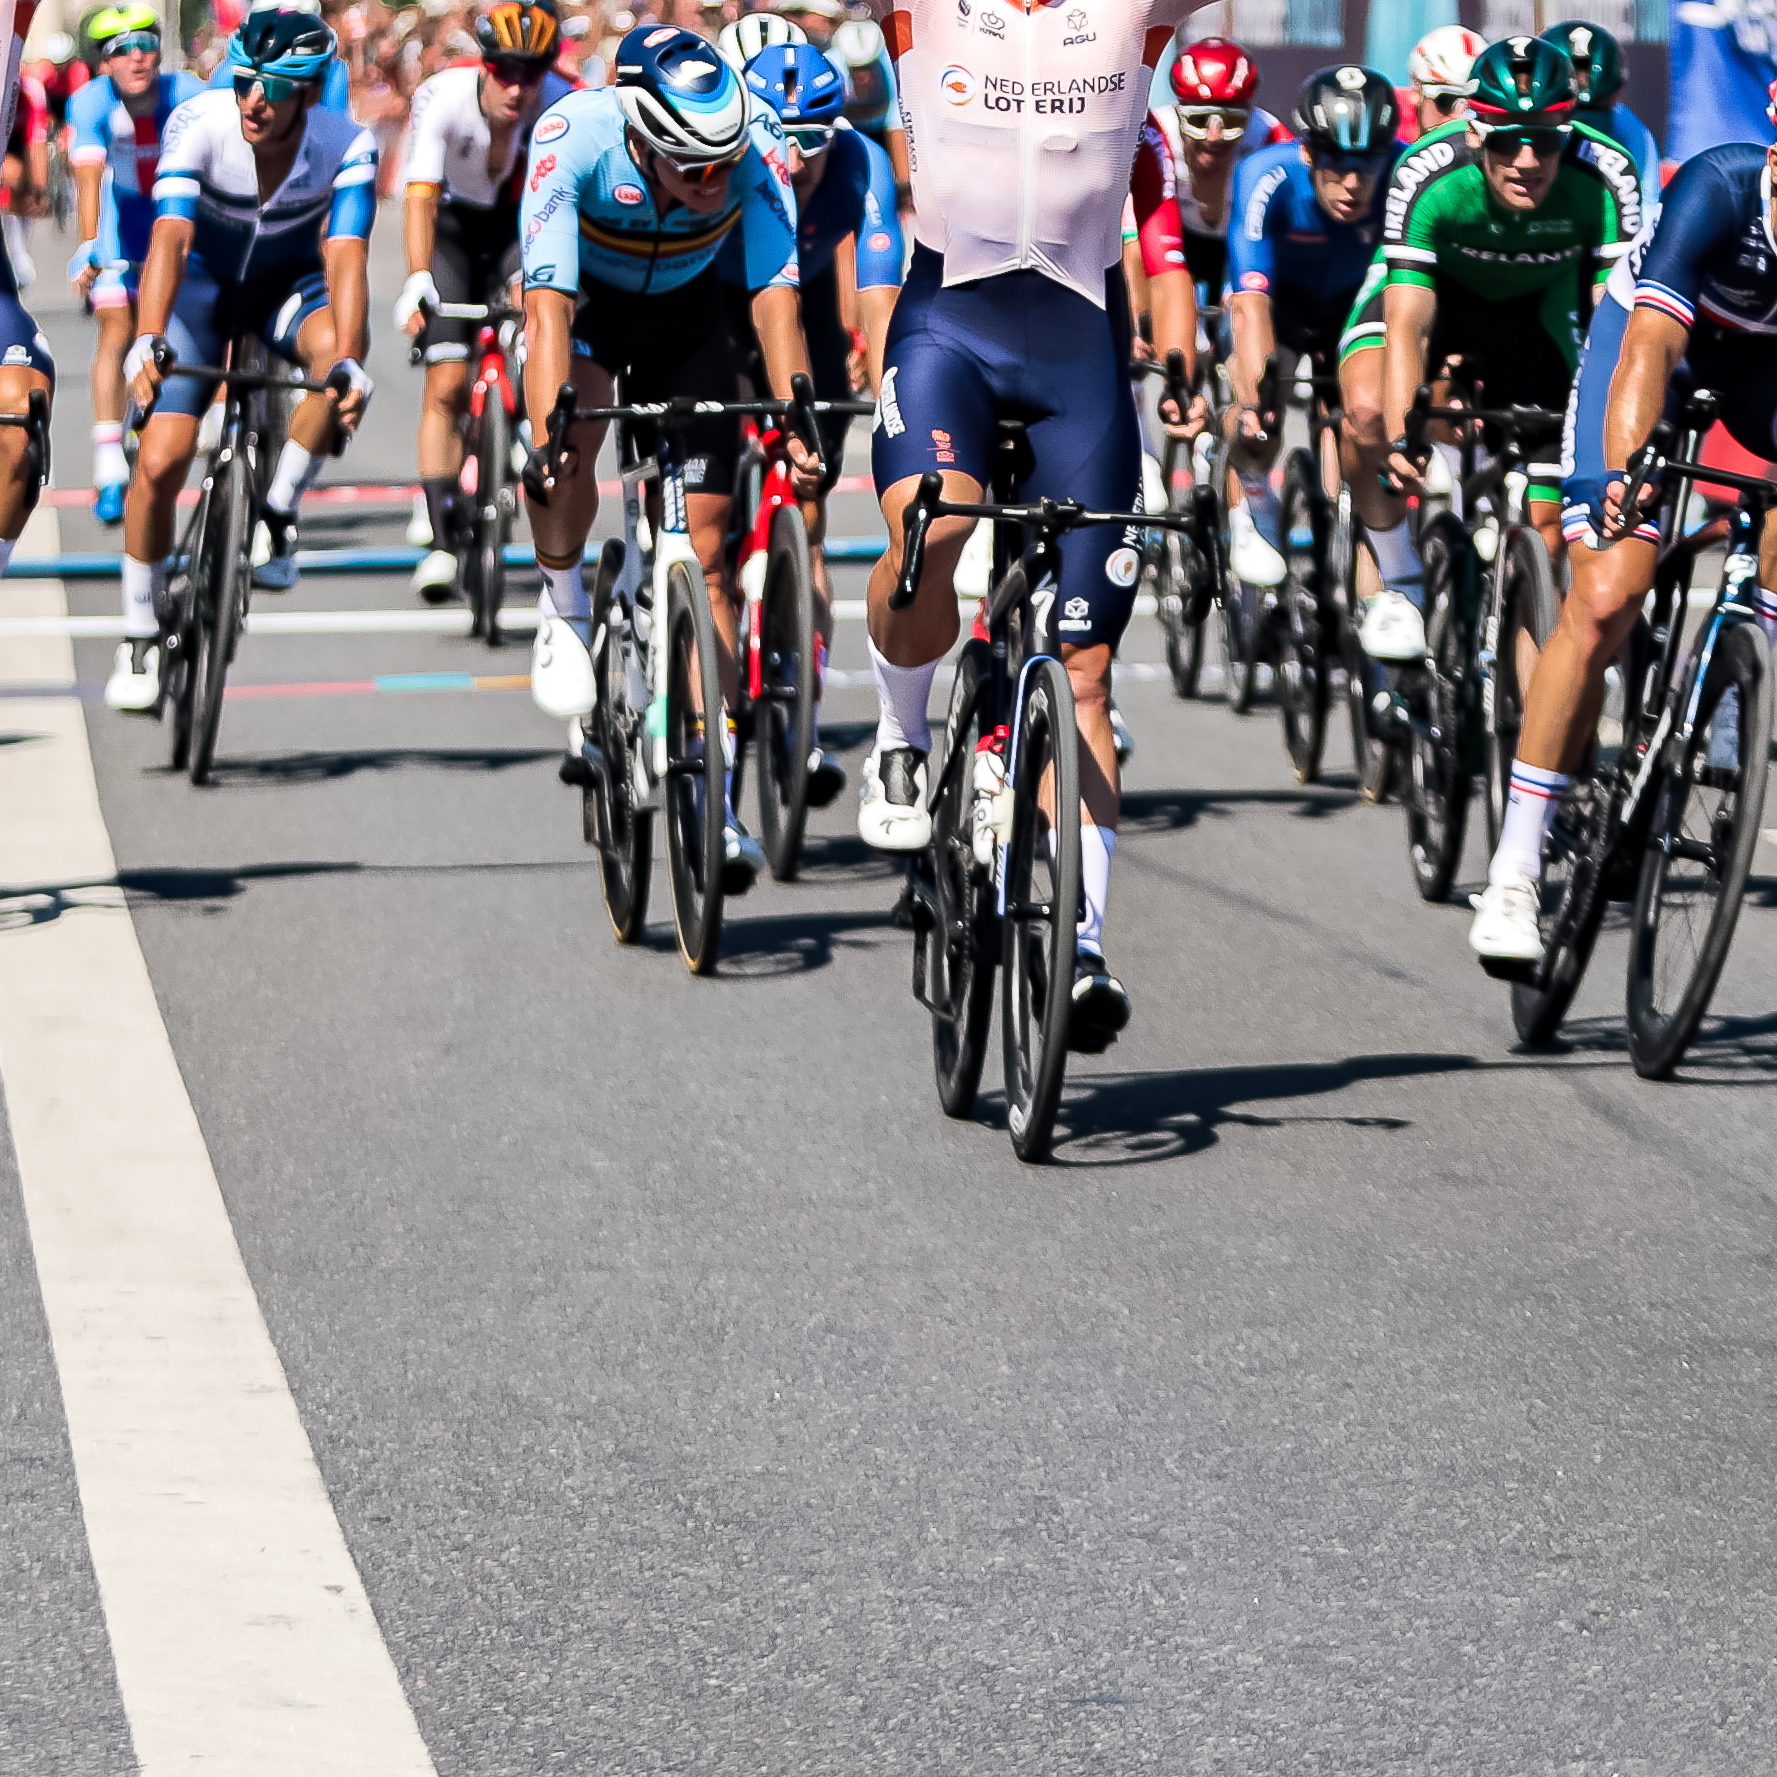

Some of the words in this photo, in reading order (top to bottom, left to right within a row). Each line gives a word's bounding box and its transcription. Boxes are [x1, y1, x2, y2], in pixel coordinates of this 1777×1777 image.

[1062, 32, 1097, 48] AGU
[984, 71, 1127, 97] NEDERLANDSE
[1382, 141, 1456, 240] IRELAND
